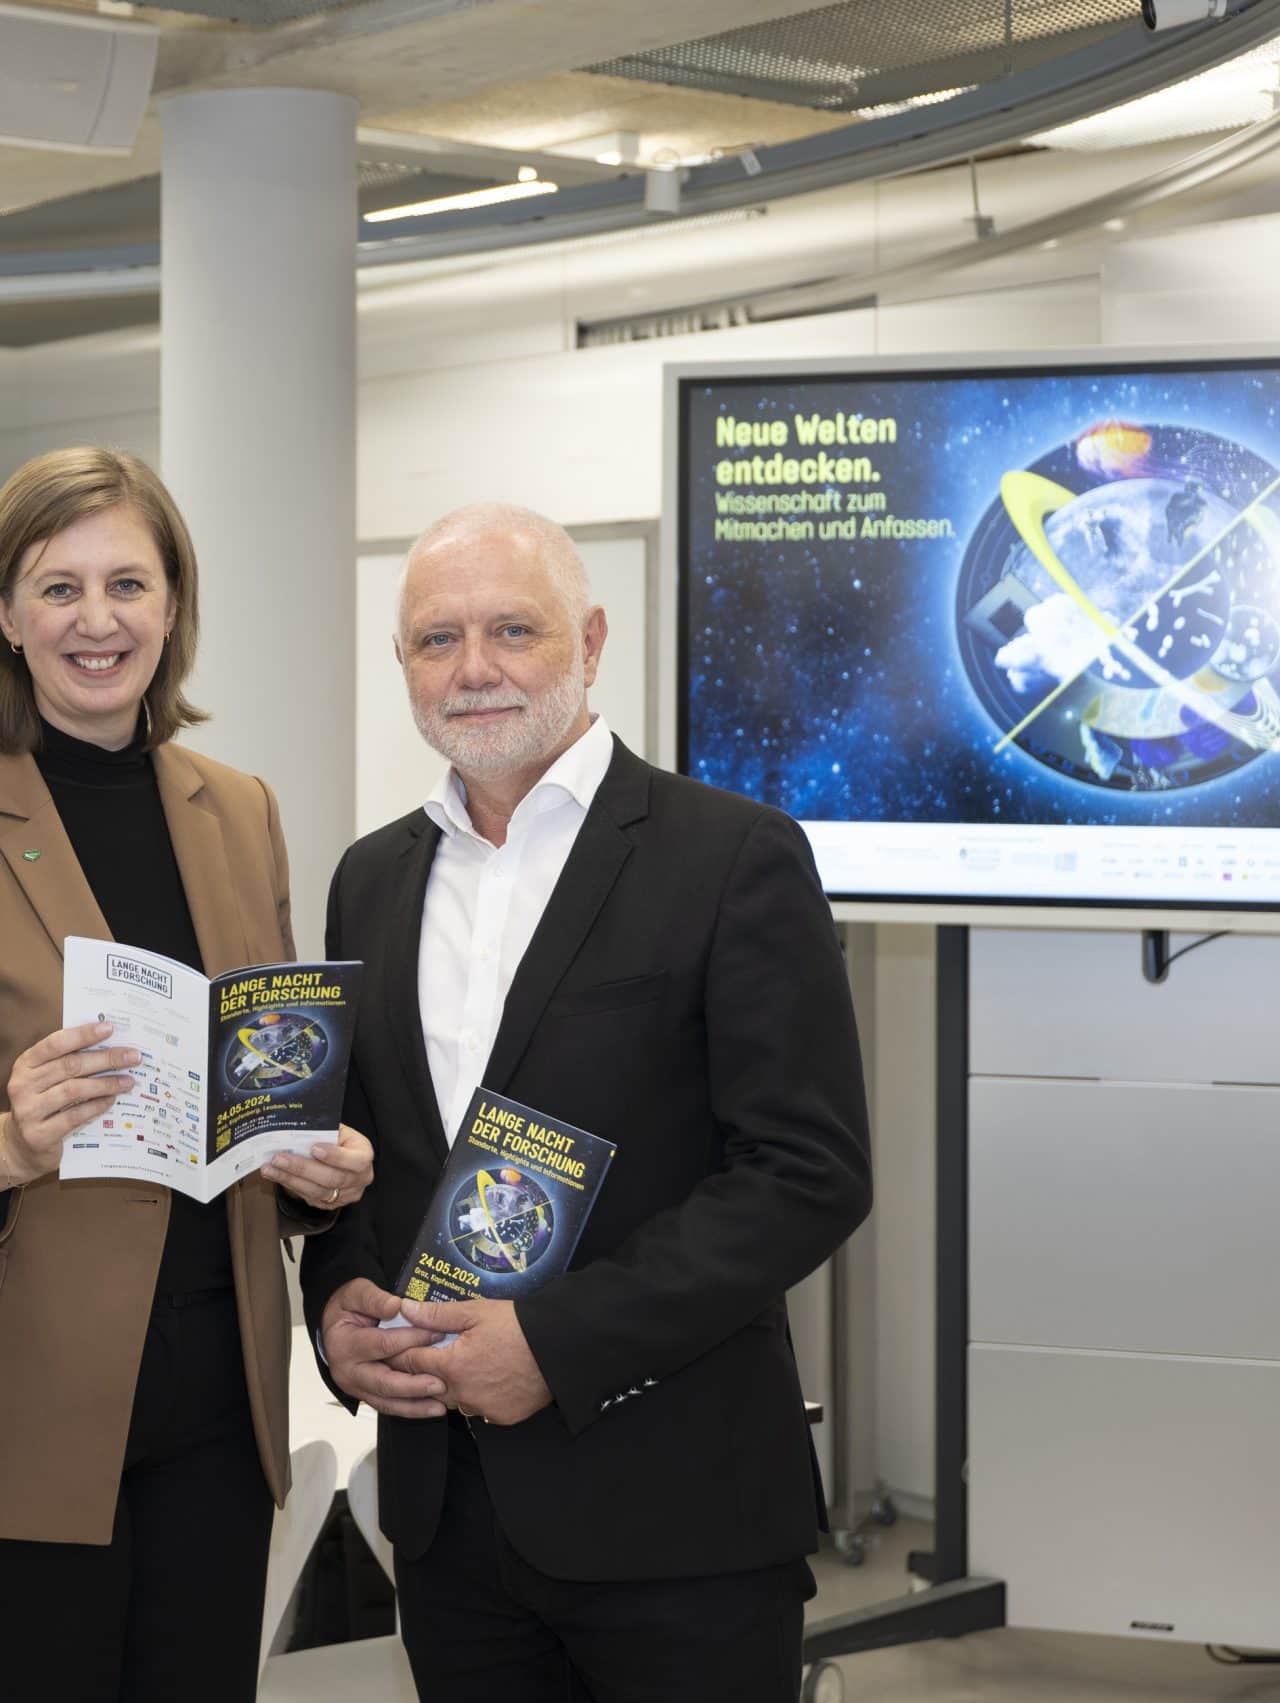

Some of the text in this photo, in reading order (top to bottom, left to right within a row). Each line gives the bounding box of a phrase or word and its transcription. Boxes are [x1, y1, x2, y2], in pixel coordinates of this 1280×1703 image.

[716, 412, 897, 447] Neue Welten
[716, 451, 881, 485] entdecken.
[715, 489, 886, 514] Wissenschaft zum
[715, 515, 956, 541] Mitmachen und Anfassen.
[112, 959, 140, 973] LANGE
[141, 967, 168, 984] NACHT
[118, 969, 168, 993] FORSCHUNG
[221, 972, 323, 1000] LANGE NACHT
[220, 986, 341, 1015] DER FORSCHUNG
[217, 1094, 271, 1125] 24.05.2024
[478, 1102, 575, 1153] LANGE NACHT
[471, 1118, 586, 1178] DER FORSCHUNG
[419, 1252, 480, 1287] 24.05.2024
